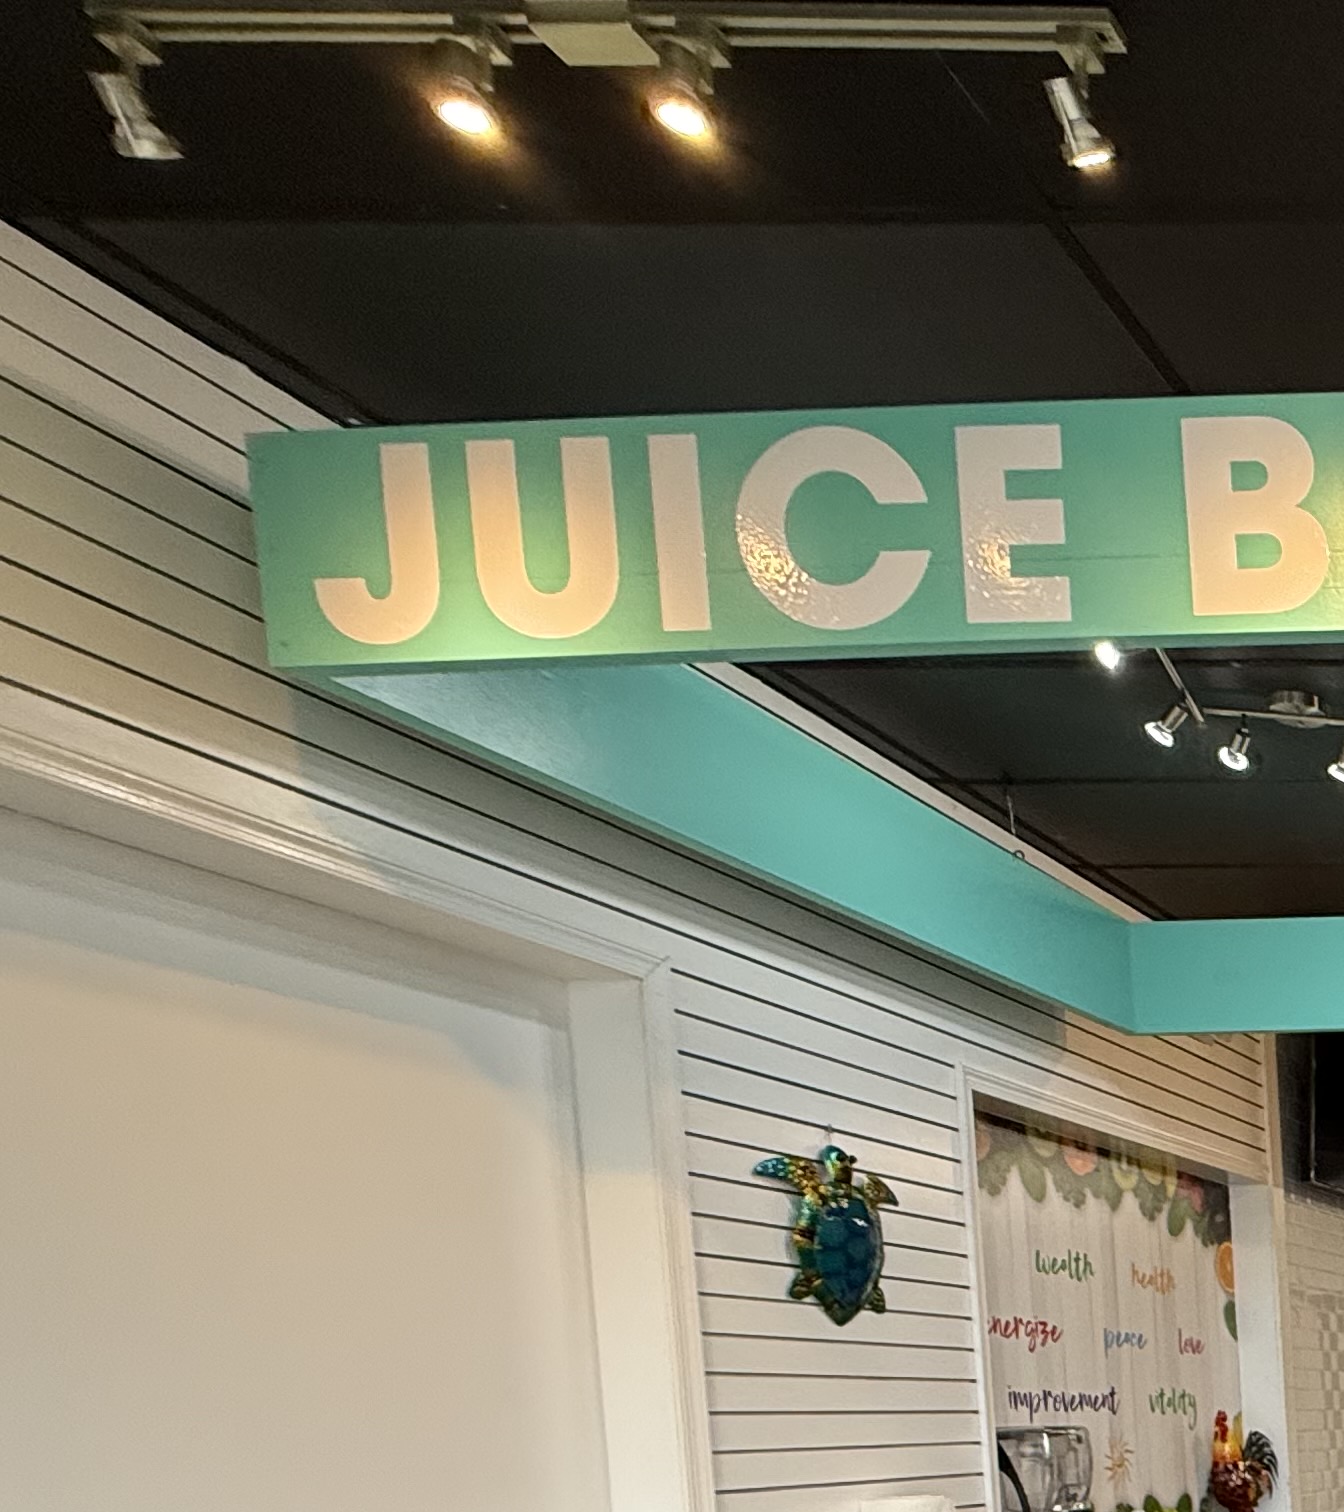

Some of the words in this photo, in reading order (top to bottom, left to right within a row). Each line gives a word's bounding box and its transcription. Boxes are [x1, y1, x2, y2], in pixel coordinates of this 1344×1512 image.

[314, 422, 1074, 647] JUICE
[1035, 1249, 1094, 1282] wealth
[1131, 1263, 1175, 1295] health
[988, 1315, 1063, 1352] nergize
[1104, 1327, 1148, 1358] peace
[1007, 1385, 1120, 1424] improvement
